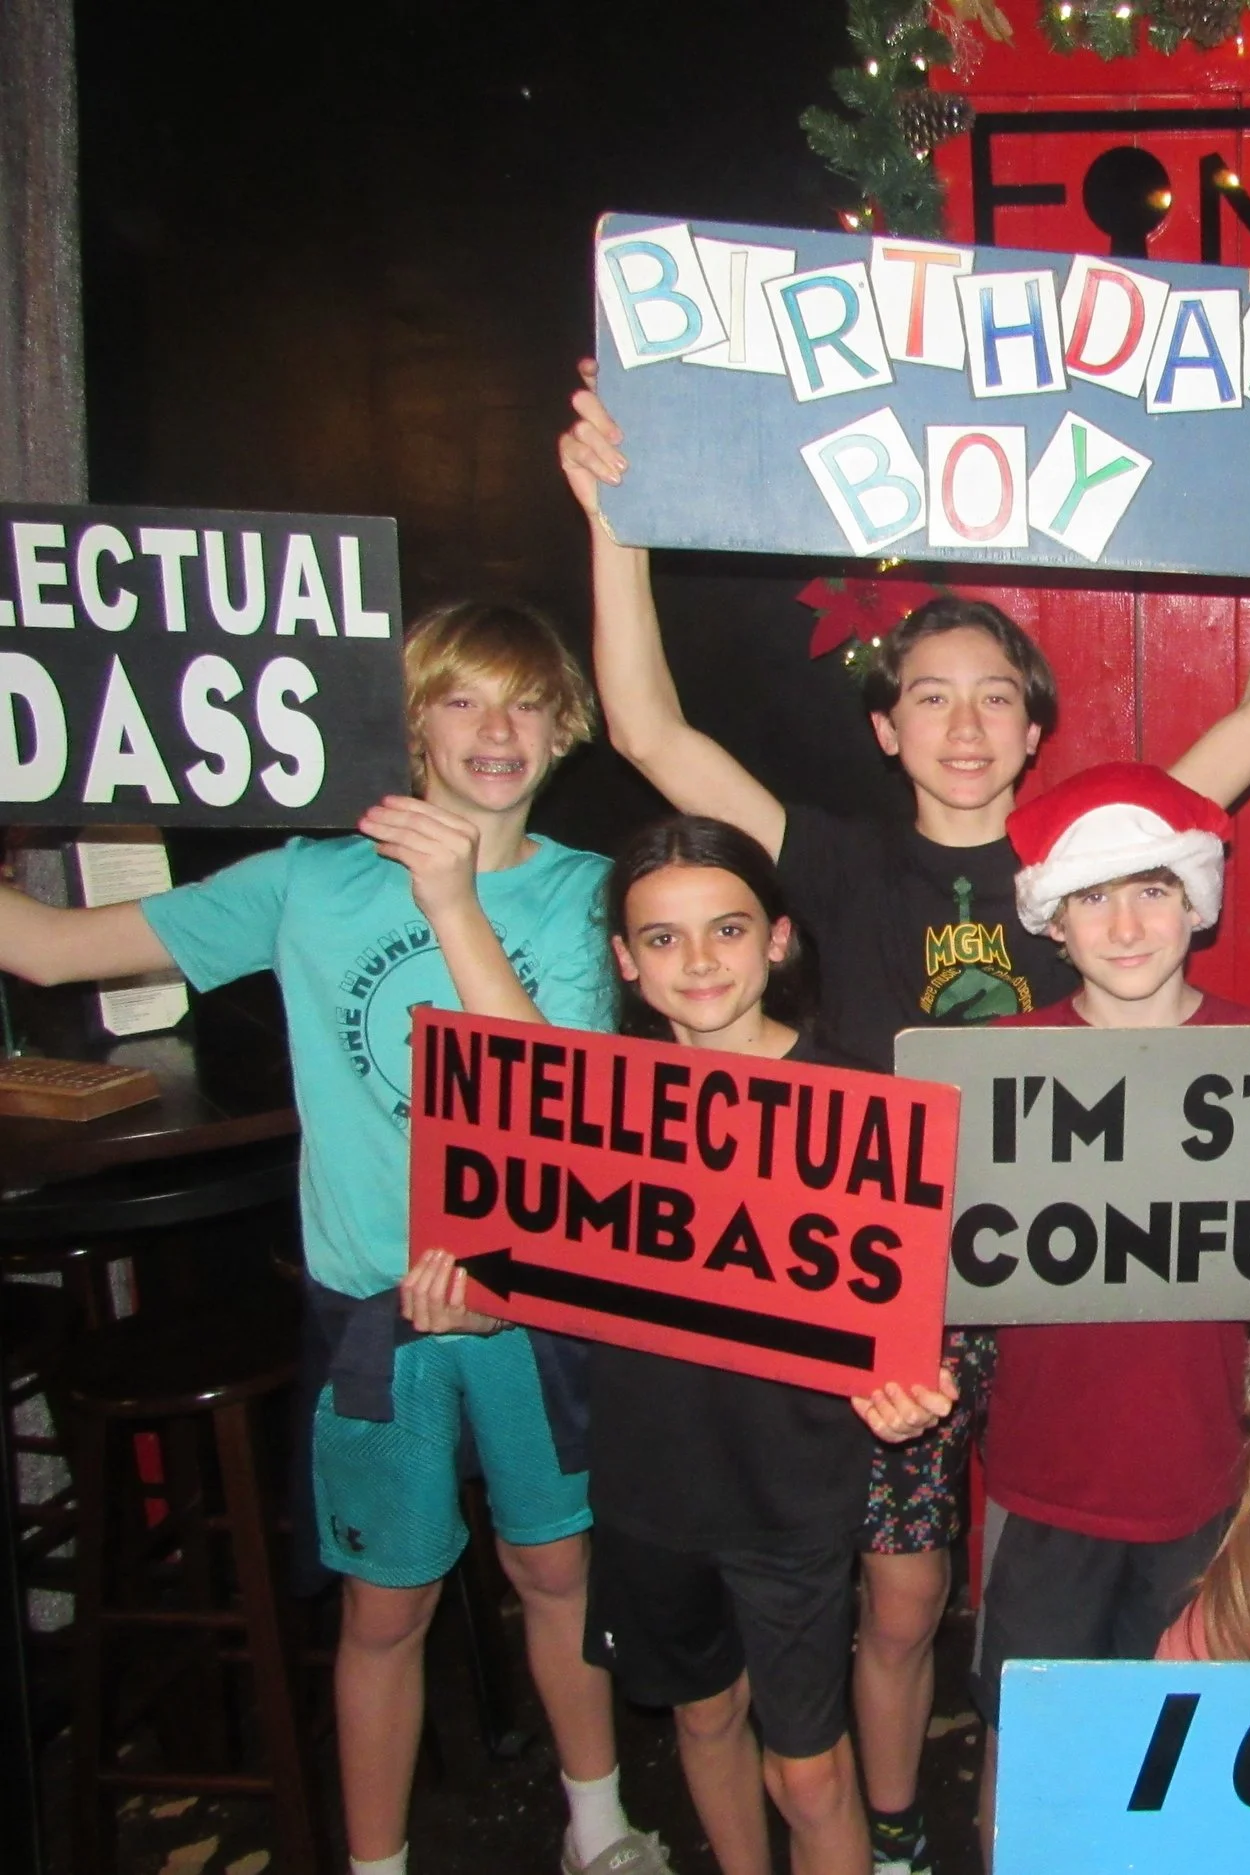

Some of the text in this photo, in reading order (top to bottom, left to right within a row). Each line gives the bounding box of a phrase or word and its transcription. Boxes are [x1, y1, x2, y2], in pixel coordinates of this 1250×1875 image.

[824, 420, 1139, 543] BOY
[0, 521, 391, 639] ECTUAL
[926, 923, 1012, 976] MGM
[423, 1024, 944, 1210] INTELLECTUAL
[992, 1075, 1127, 1164] I'M
[443, 1144, 903, 1304] DUMBASS
[1126, 1692, 1201, 1812] I
